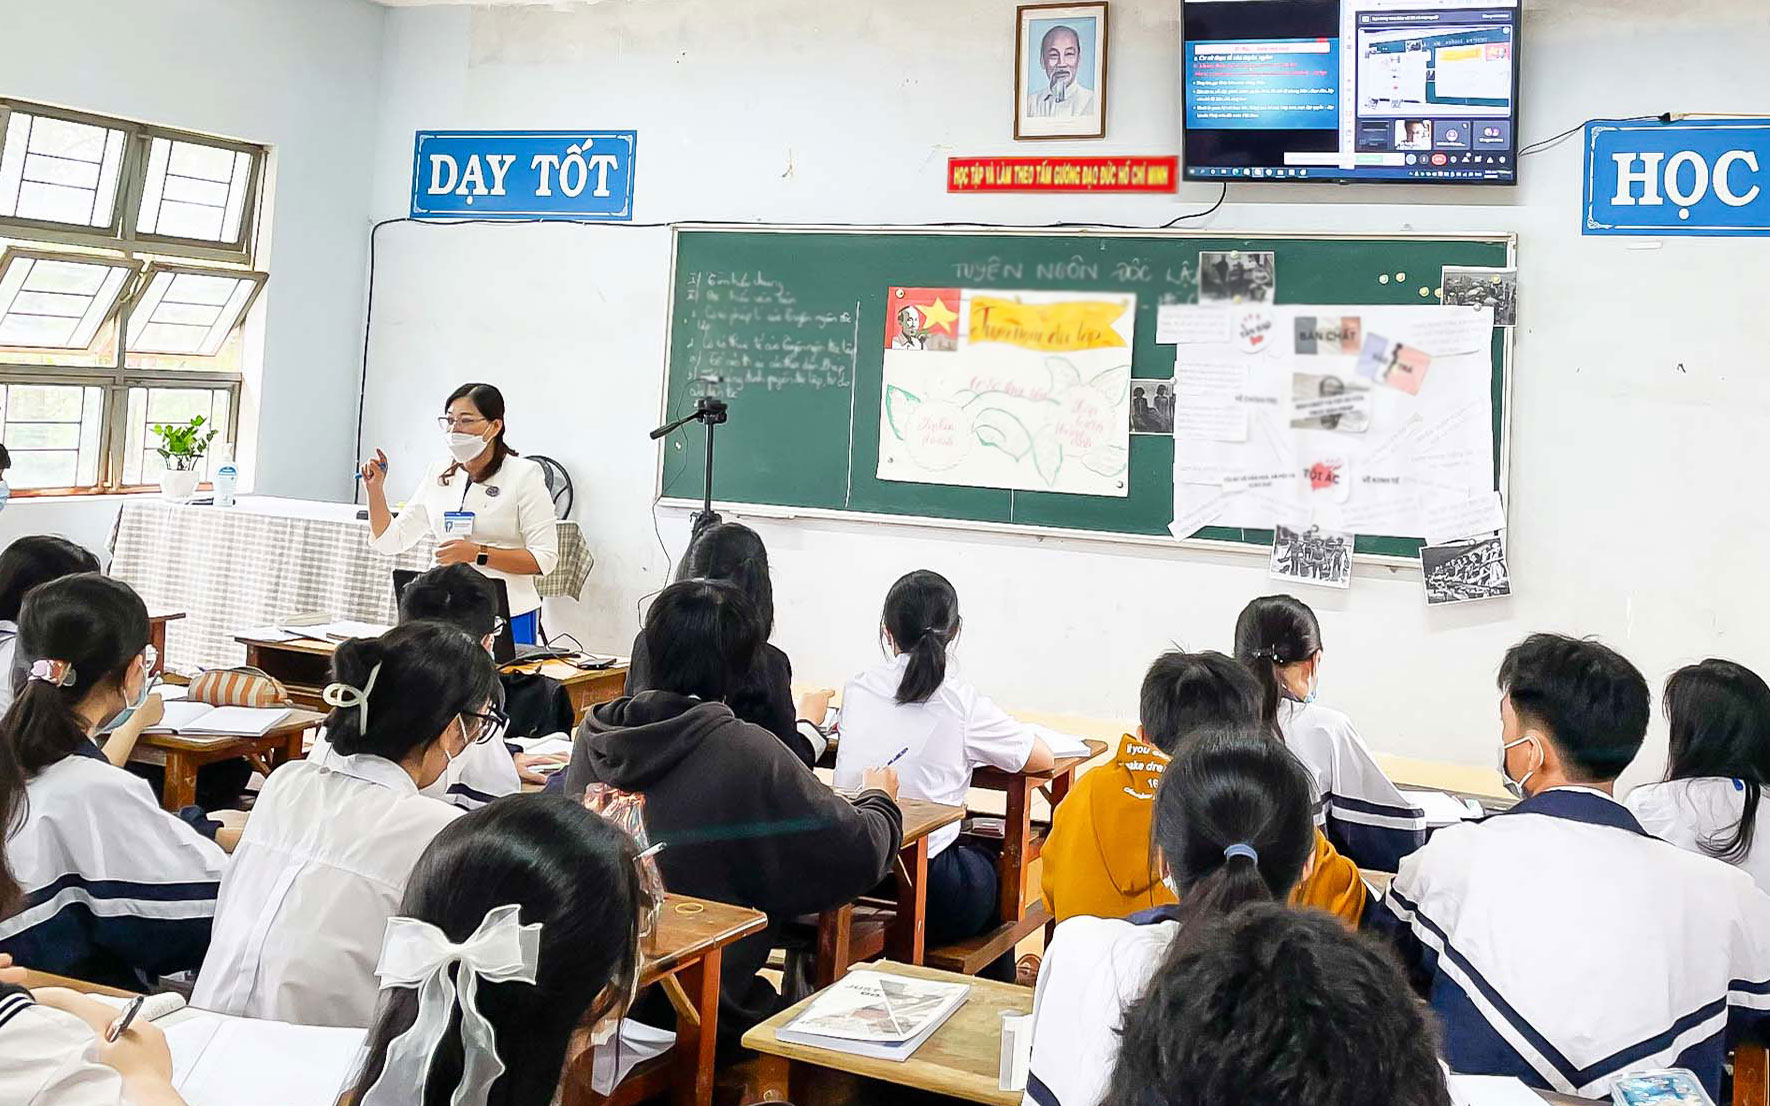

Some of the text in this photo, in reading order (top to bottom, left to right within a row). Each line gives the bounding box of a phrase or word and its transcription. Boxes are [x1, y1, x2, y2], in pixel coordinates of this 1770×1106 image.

[427, 138, 618, 205] DẠY TỐT
[954, 160, 1169, 188] HỌC TẬP VÀ LÀM THEO TẤM GƯƠNG ĐẠO ĐỨC HỒ CHÍ MINH
[1611, 150, 1760, 220] HỌC
[954, 255, 1023, 283] TUYÊN
[1037, 254, 1098, 281] NGÔN
